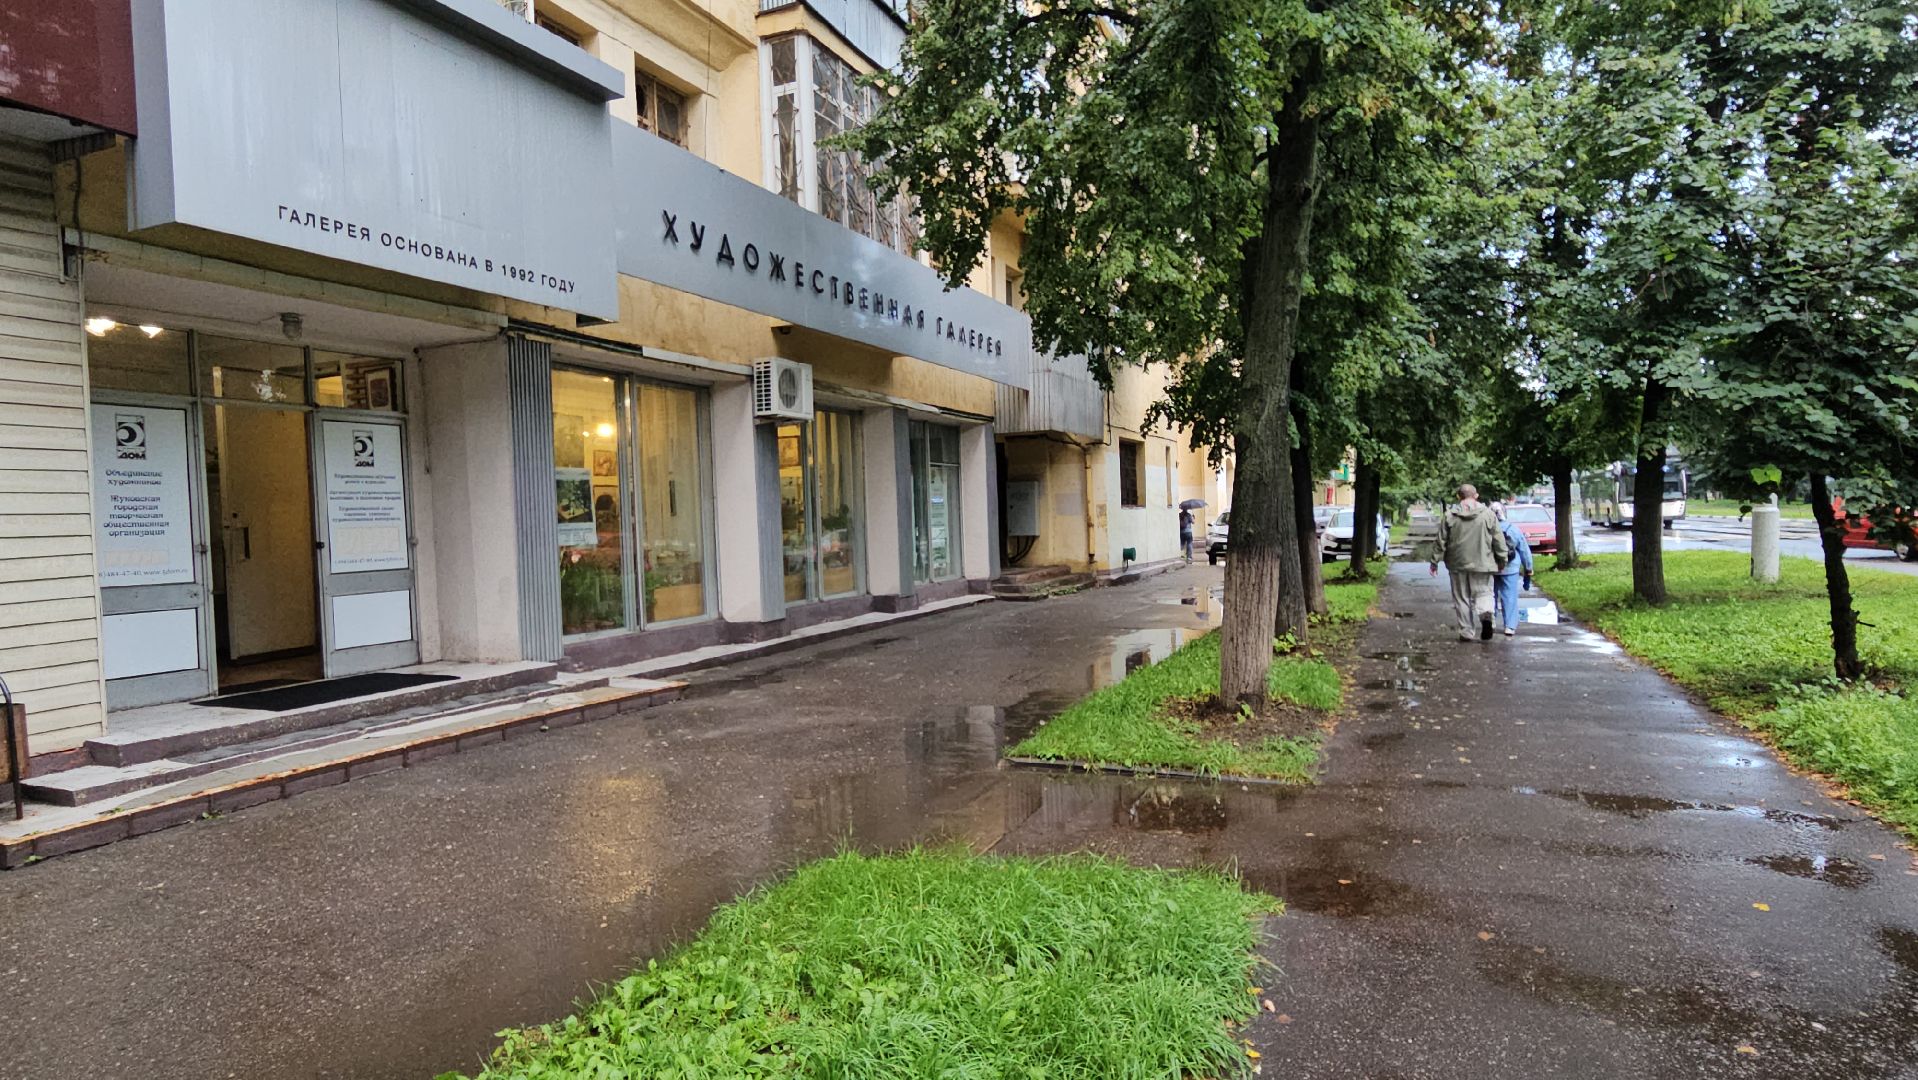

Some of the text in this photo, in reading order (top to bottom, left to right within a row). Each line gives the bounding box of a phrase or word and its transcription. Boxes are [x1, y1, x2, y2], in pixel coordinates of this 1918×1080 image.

[278, 205, 576, 294] ГАЛЕРЕЯ ОСНОВАНА В 1992 ГОДУ
[661, 208, 1002, 357] ХУДОЖЕСТВЕННАЯ ГАЛЕРЕЯ
